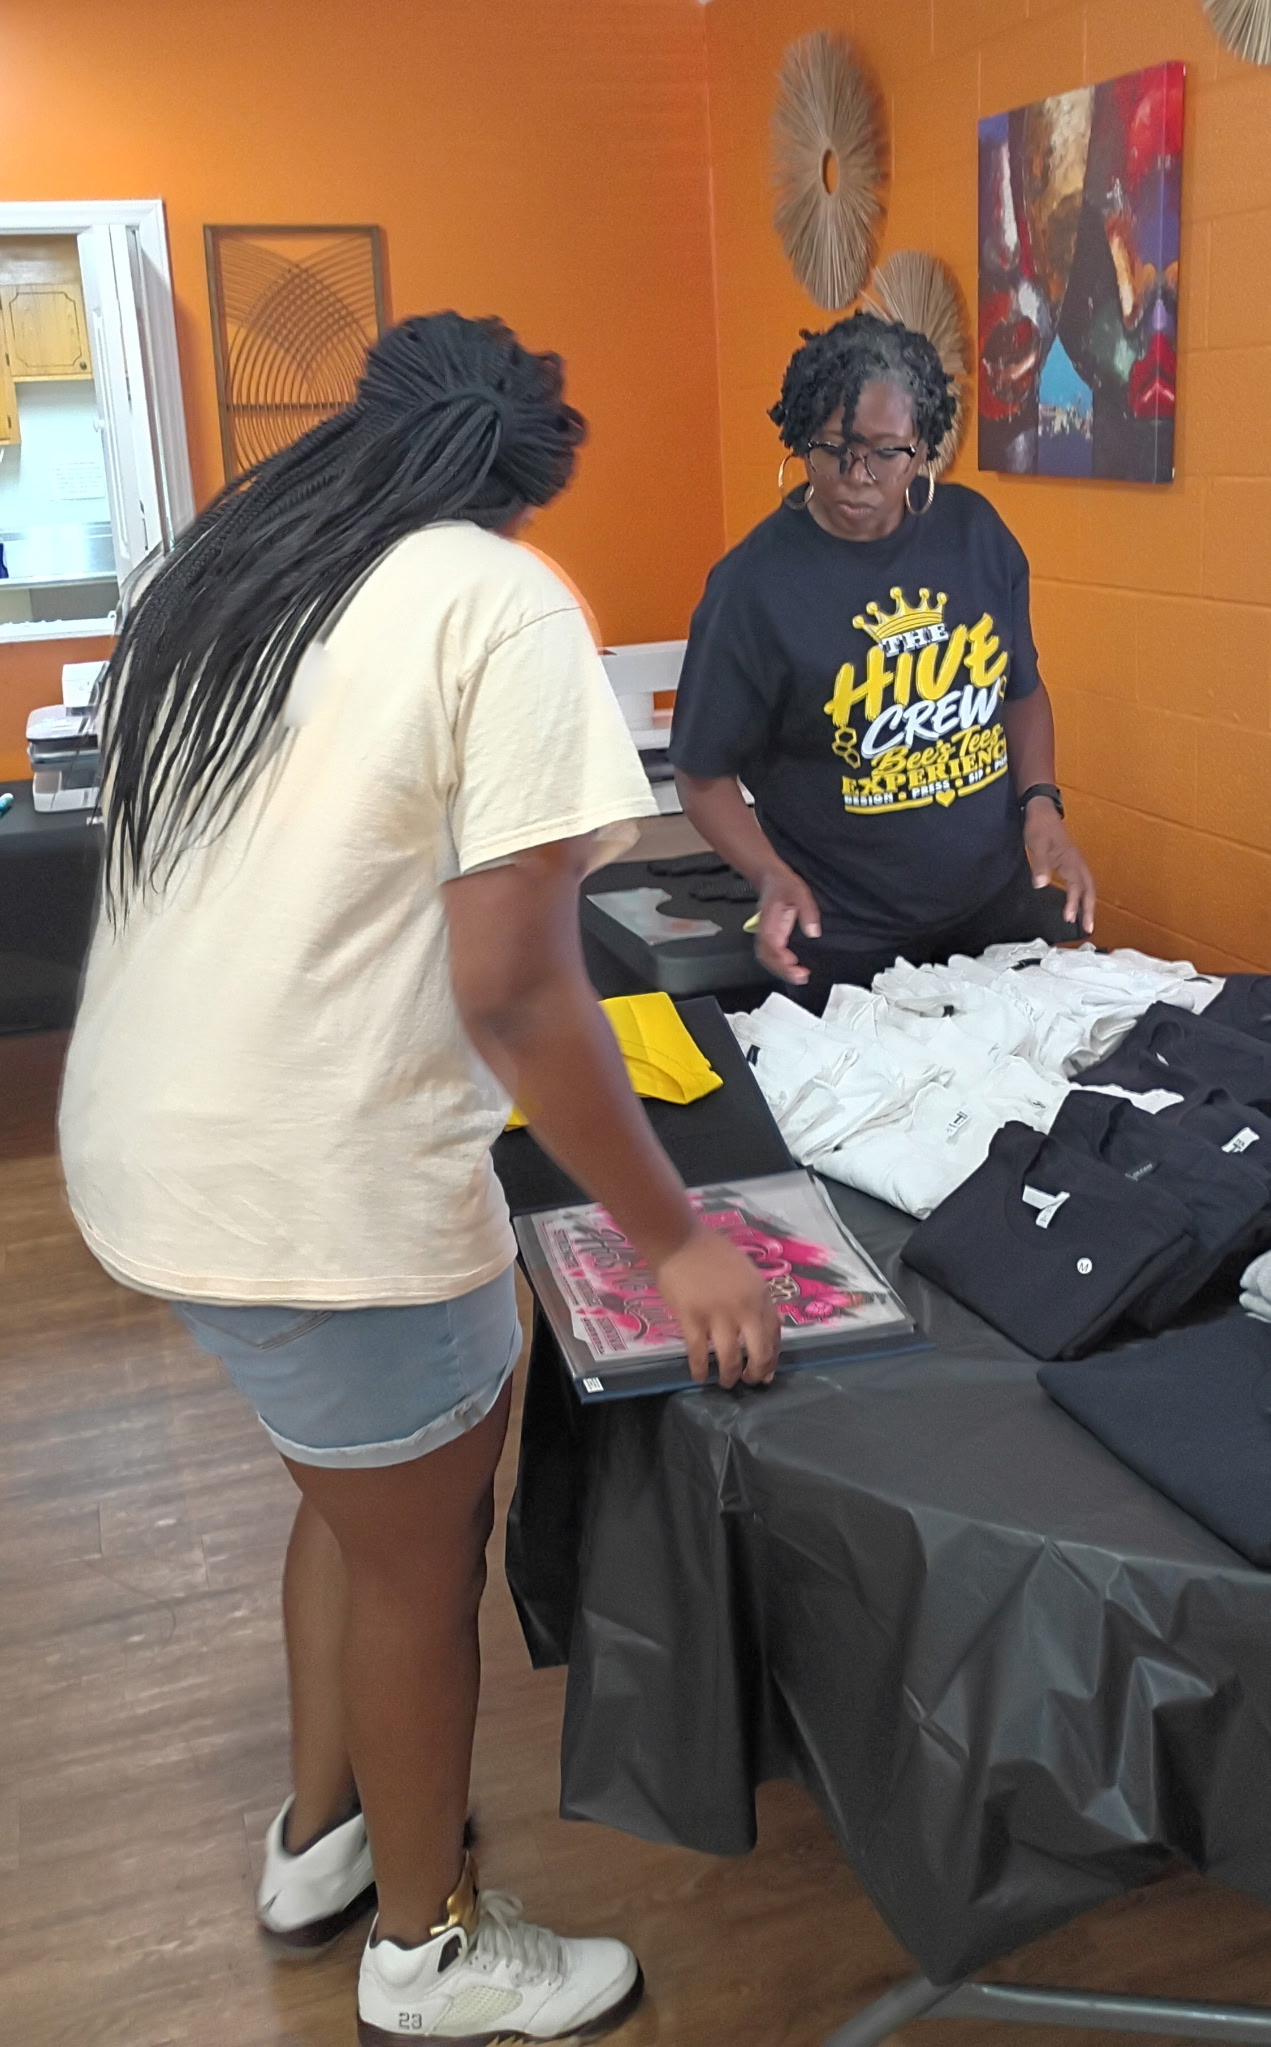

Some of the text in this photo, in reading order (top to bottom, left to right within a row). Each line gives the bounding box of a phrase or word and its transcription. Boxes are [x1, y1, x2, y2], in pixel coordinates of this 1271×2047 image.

[880, 622, 949, 657] THE
[824, 612, 1008, 726] HIVE
[861, 677, 1001, 759] CREW
[841, 736, 1008, 796] EXPERIENC
[871, 740, 956, 777] Bee's
[951, 723, 1003, 757] Tees
[911, 780, 951, 799] PRESS
[398, 2012, 423, 2029] 23
